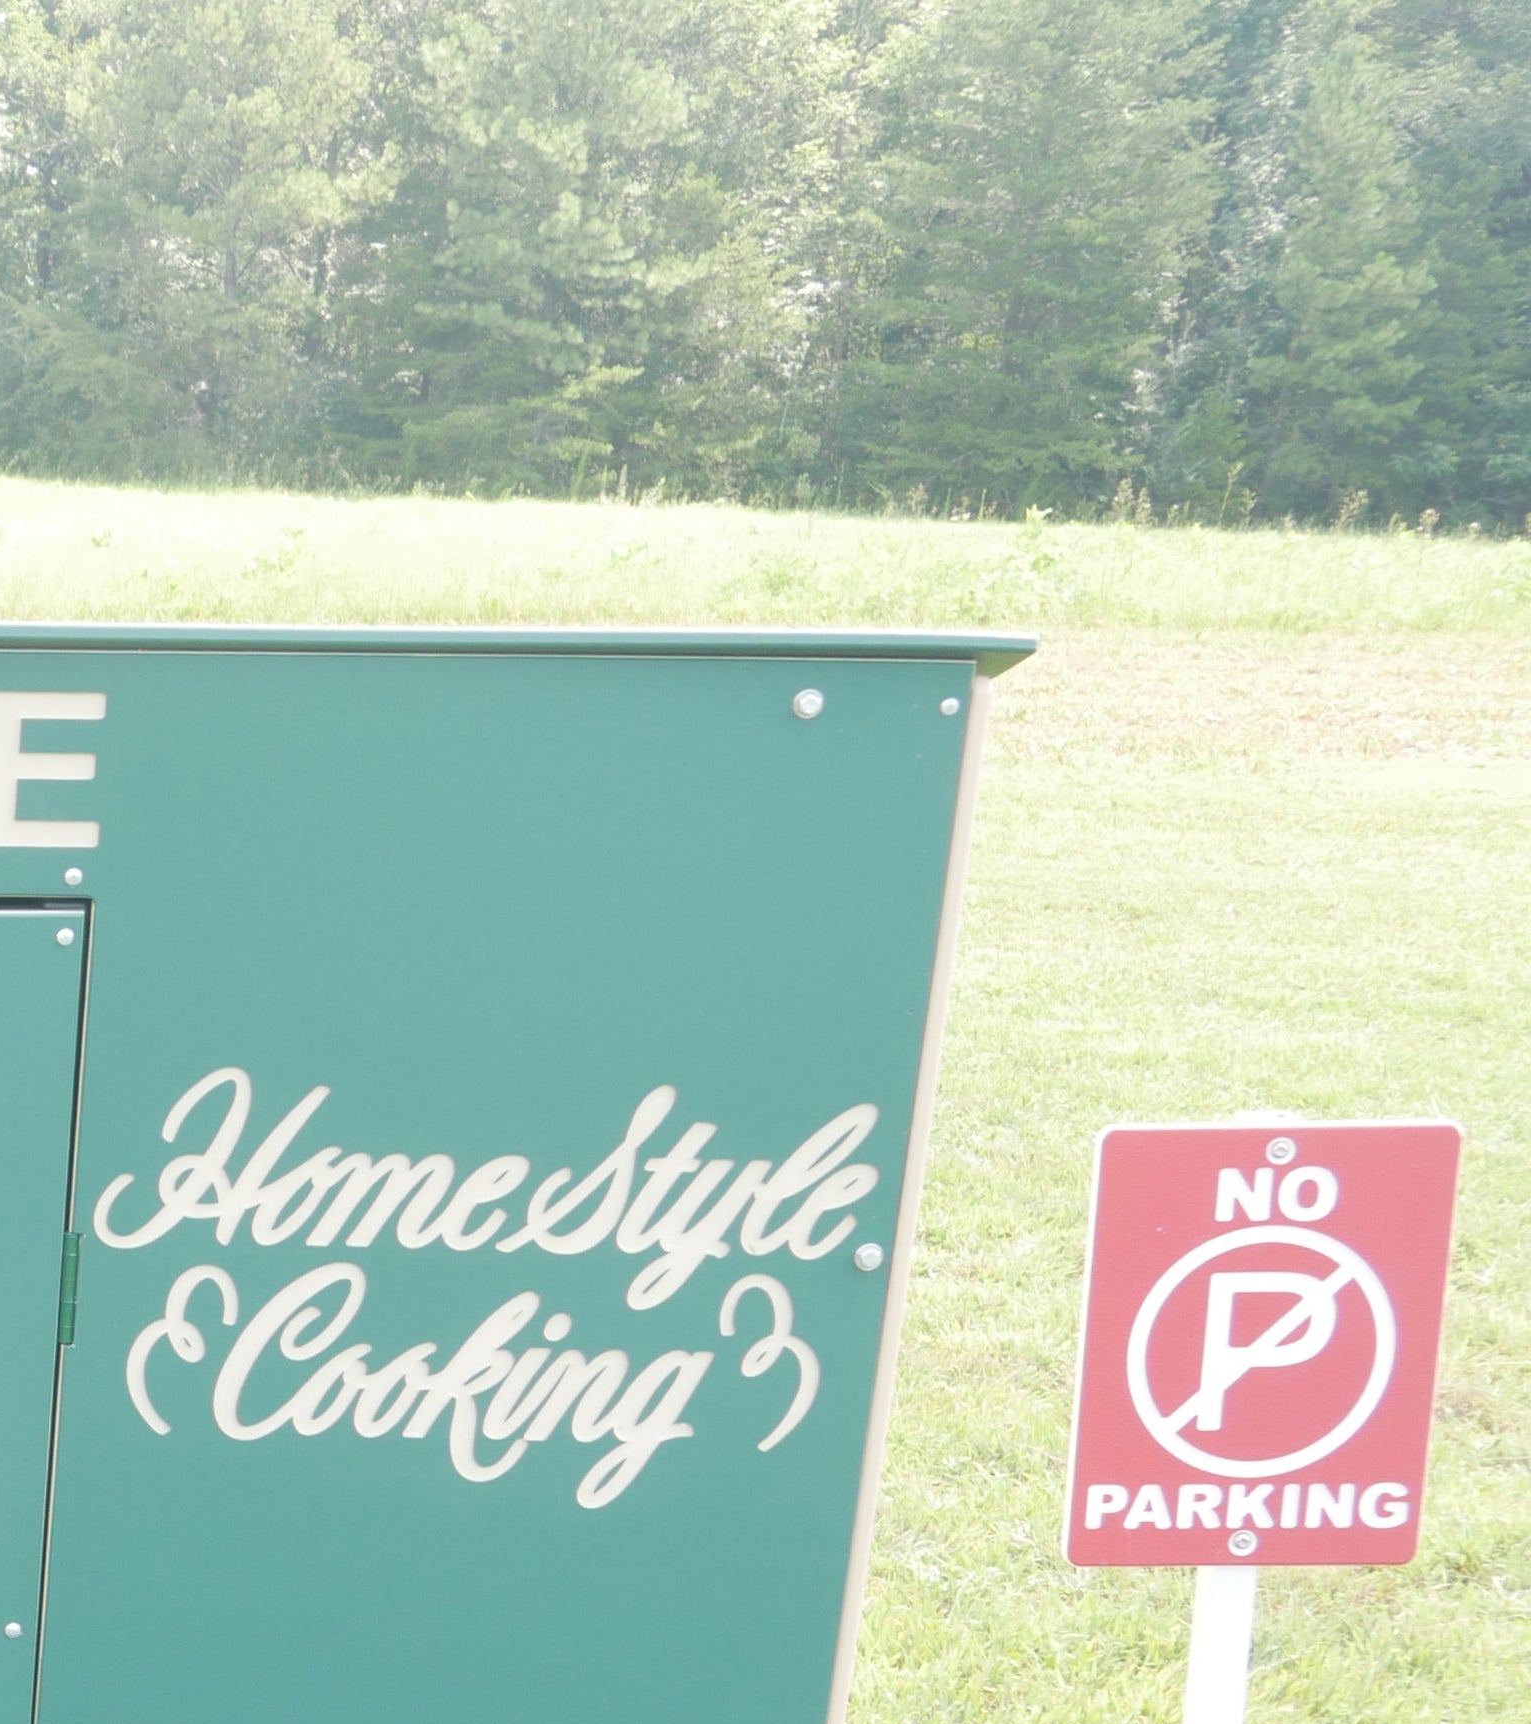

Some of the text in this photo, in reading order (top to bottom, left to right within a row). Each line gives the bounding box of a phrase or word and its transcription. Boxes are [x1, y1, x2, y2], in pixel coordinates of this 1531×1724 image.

[1213, 1164, 1340, 1223] NO
[212, 1262, 714, 1510] Cooking
[1083, 1480, 1410, 1531] PARKING
